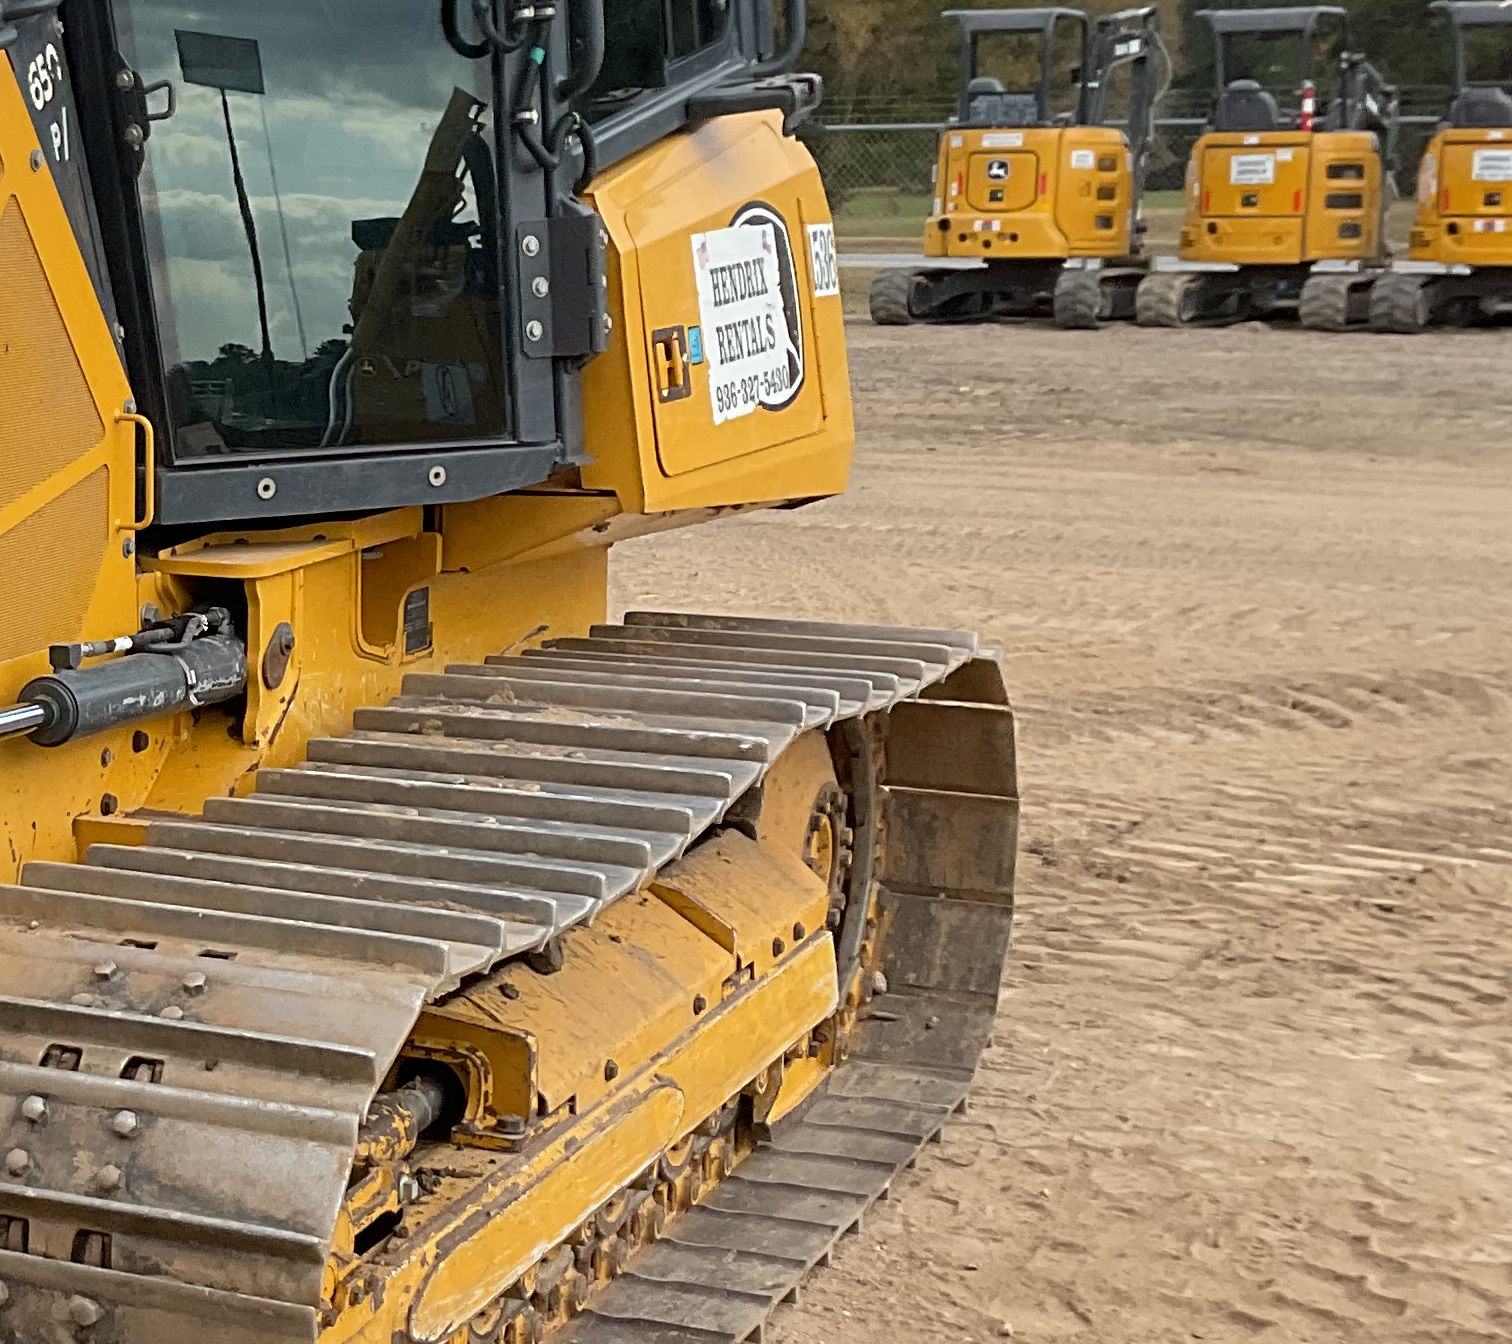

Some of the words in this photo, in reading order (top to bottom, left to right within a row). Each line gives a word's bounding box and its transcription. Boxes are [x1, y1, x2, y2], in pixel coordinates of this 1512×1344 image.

[710, 257, 768, 307] HENDRIX
[716, 313, 776, 365] RENTALS
[716, 365, 789, 413] 936-327-5430
